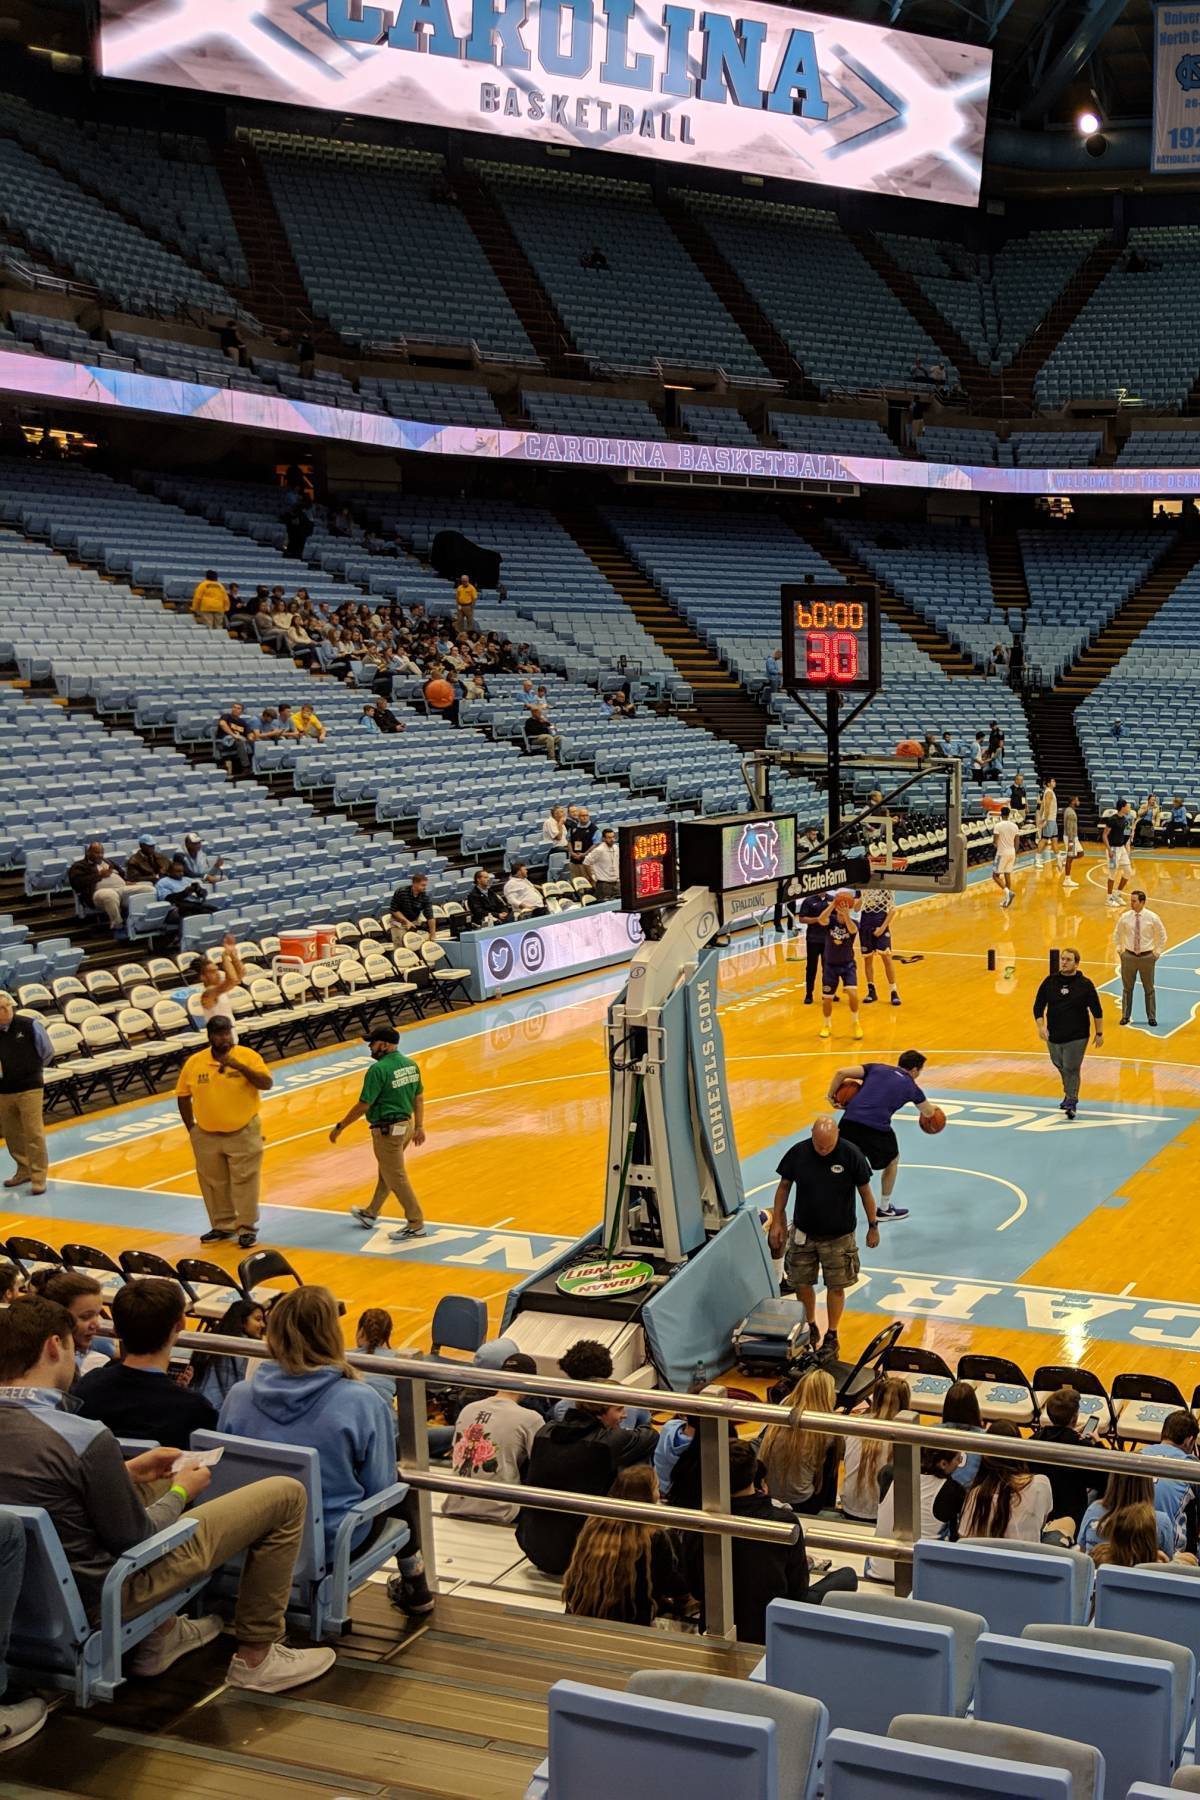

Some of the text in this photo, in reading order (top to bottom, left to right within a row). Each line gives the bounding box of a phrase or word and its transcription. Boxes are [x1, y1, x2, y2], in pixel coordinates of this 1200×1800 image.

[1160, 30, 1191, 46] North
[480, 82, 696, 145] BASKETBALL
[523, 433, 849, 480] CAROLINA BASKETBALL
[1055, 474, 1114, 489] WELCOME
[1120, 474, 1136, 488] TO
[1141, 474, 1163, 488] THE
[1167, 474, 1200, 488] DEAN
[808, 633, 858, 679] 30
[731, 892, 765, 914] SPALDING
[725, 987, 796, 1012] COURT
[697, 980, 727, 1155] GOHEELS.COM
[565, 1261, 634, 1280] LIBMAN
[577, 1274, 647, 1294] LIBMAN
